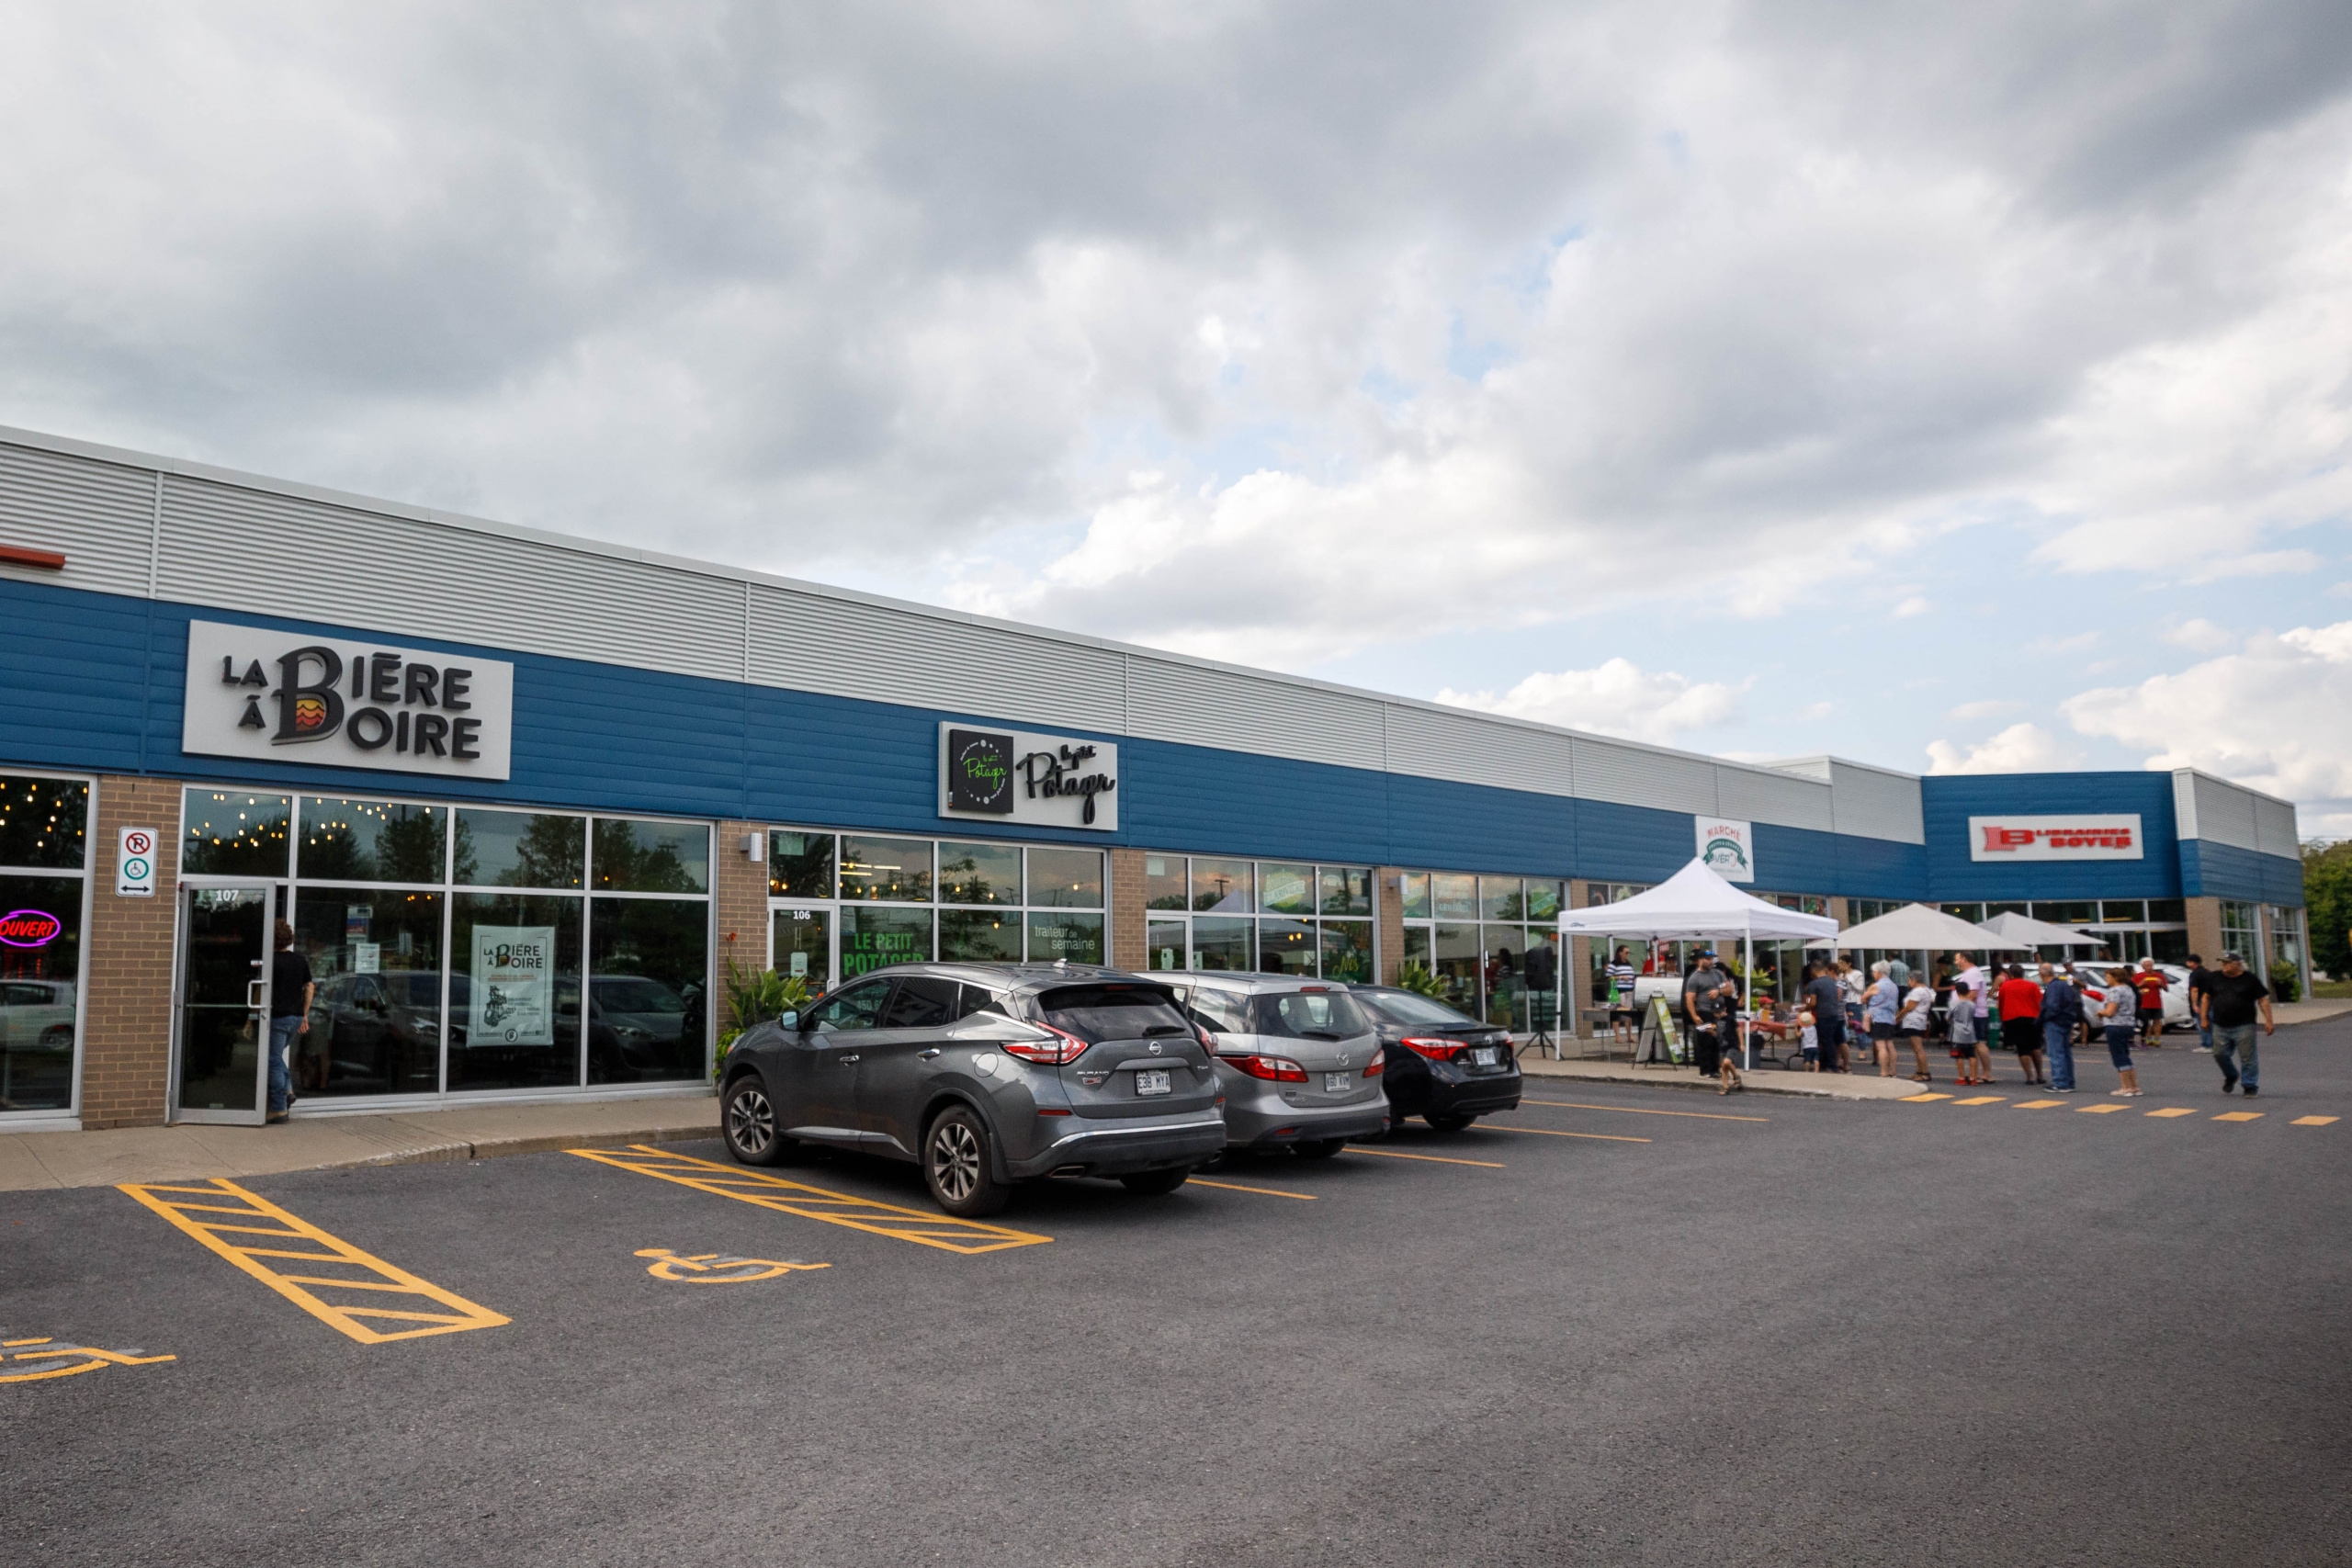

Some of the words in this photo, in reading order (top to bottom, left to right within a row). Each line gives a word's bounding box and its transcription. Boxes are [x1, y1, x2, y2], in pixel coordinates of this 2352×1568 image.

[221, 656, 268, 687] LA
[963, 758, 1007, 790] Potager
[1015, 752, 1115, 824] Potager
[1707, 825, 1741, 841] MARCHÉ
[2051, 837, 2132, 849] BOYER
[216, 890, 239, 901] 107
[793, 911, 810, 919] 106
[0, 921, 56, 937] OUVERT
[1035, 925, 1069, 937] traiteur
[854, 933, 871, 950] LE
[876, 933, 912, 950] PETIT
[1051, 939, 1095, 950] semaine
[1138, 1077, 1152, 1089] E38
[1156, 1076, 1170, 1088] MYA
